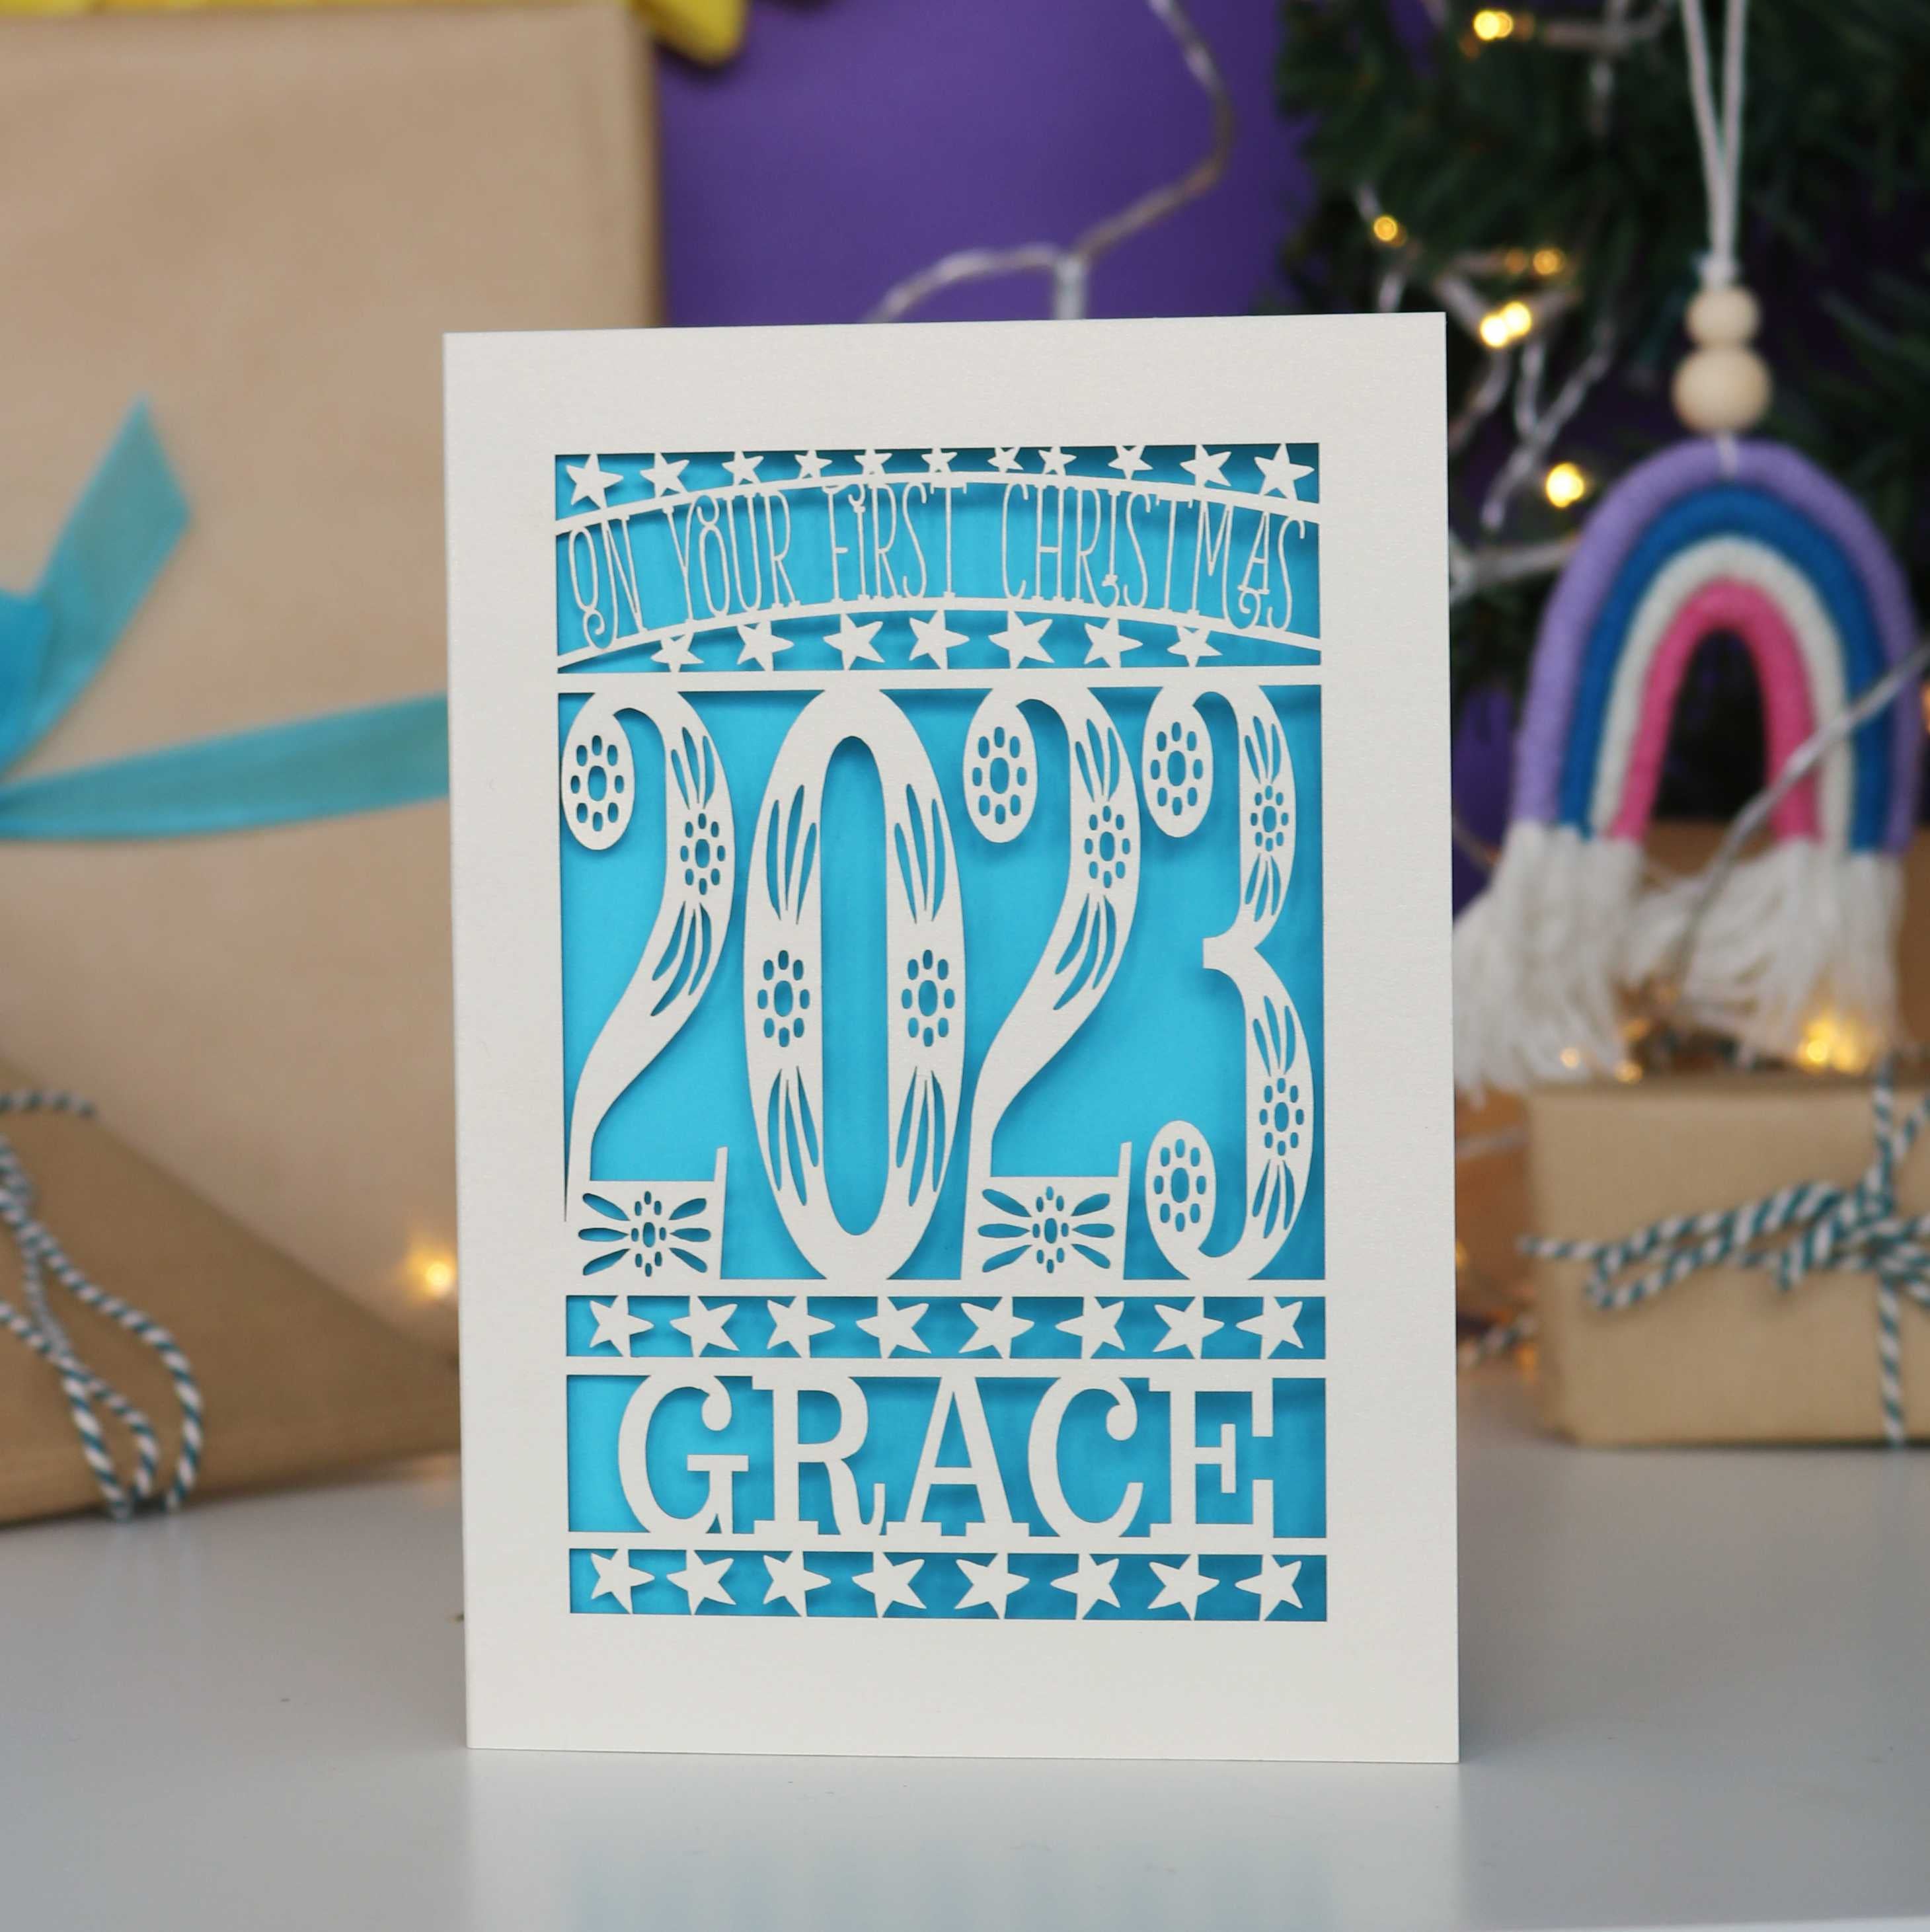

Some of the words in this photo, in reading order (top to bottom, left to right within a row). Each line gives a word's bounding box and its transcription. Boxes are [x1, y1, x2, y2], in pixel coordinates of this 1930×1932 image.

[568, 516, 648, 650] ON
[662, 490, 801, 624] YOUR
[822, 482, 967, 603] FIRST
[1001, 483, 1306, 631] CHRISTMAS
[561, 687, 1314, 1280] 2023
[617, 1374, 1274, 1538] GRACE
